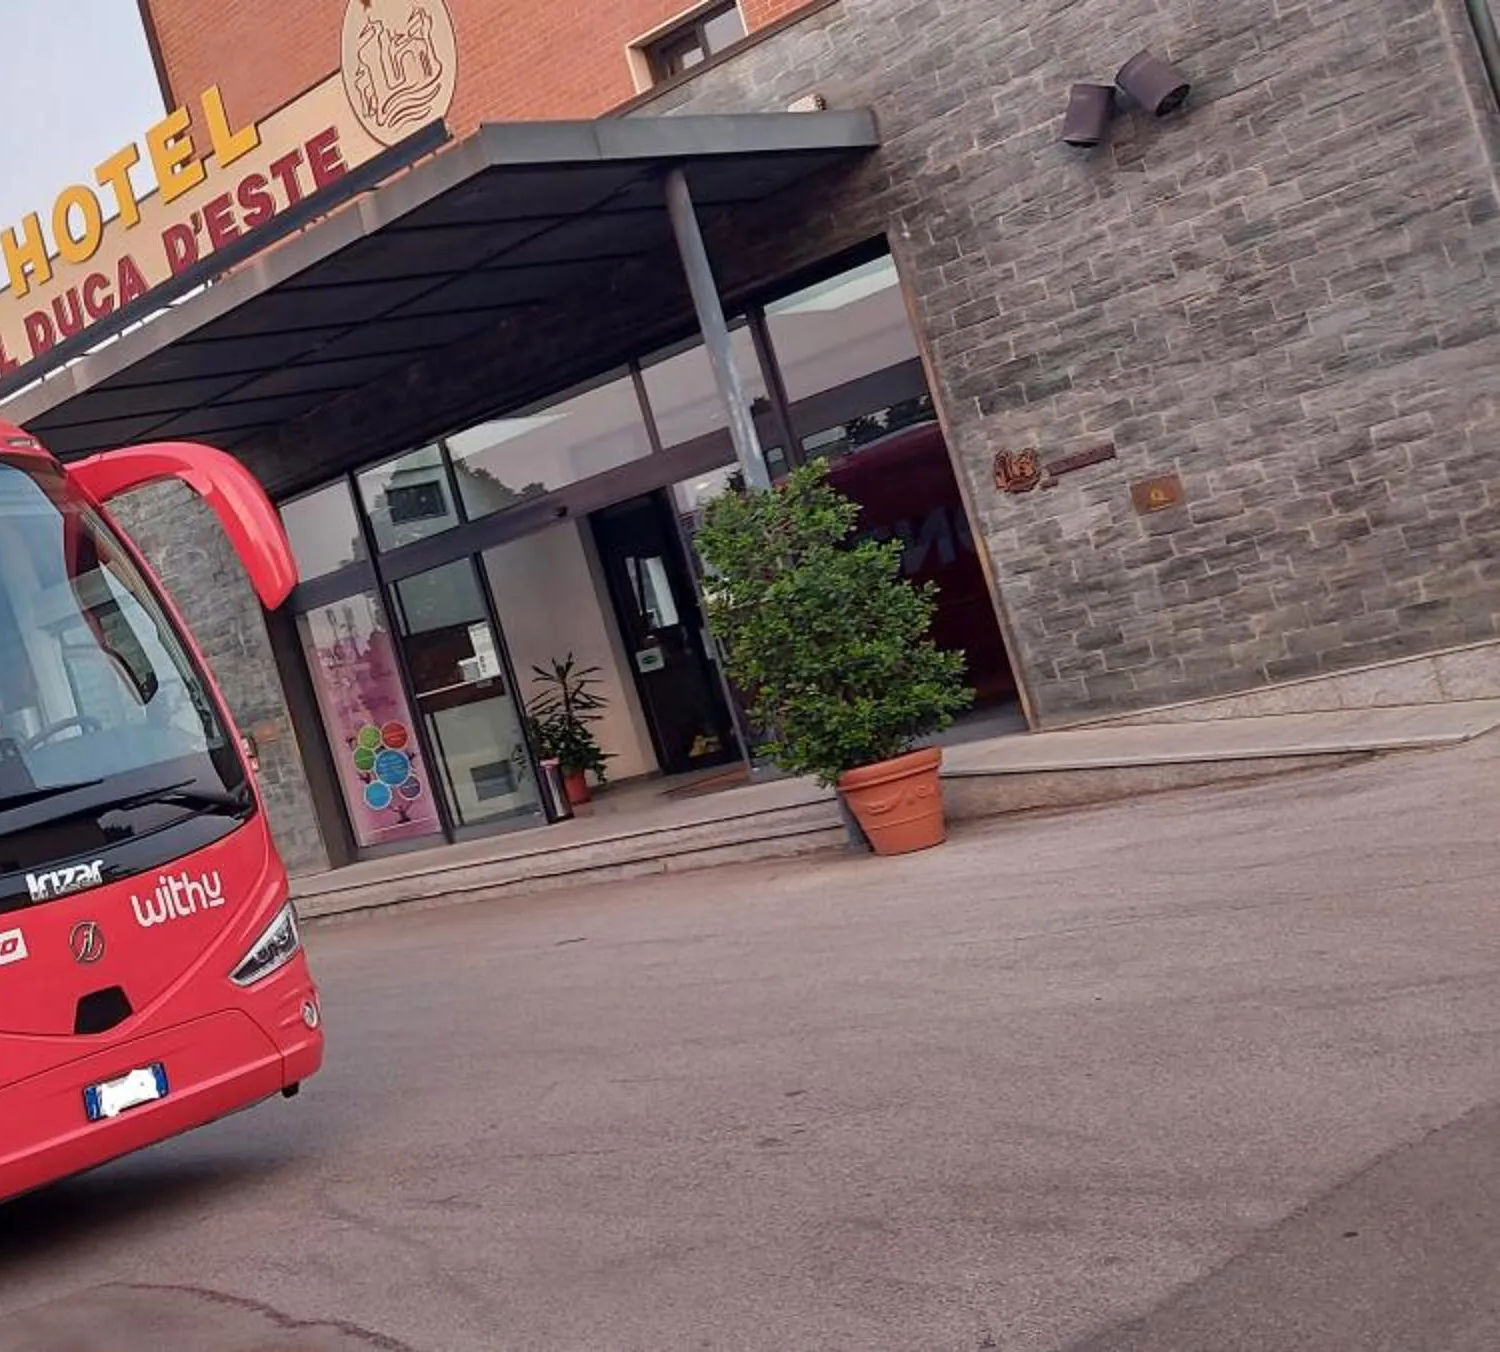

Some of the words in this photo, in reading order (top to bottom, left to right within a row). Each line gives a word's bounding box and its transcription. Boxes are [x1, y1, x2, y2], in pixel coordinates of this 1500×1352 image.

[0, 84, 259, 297] HOTEL
[24, 254, 151, 356] DUCA
[162, 126, 350, 279] D'ESTE
[130, 870, 226, 928] withu
